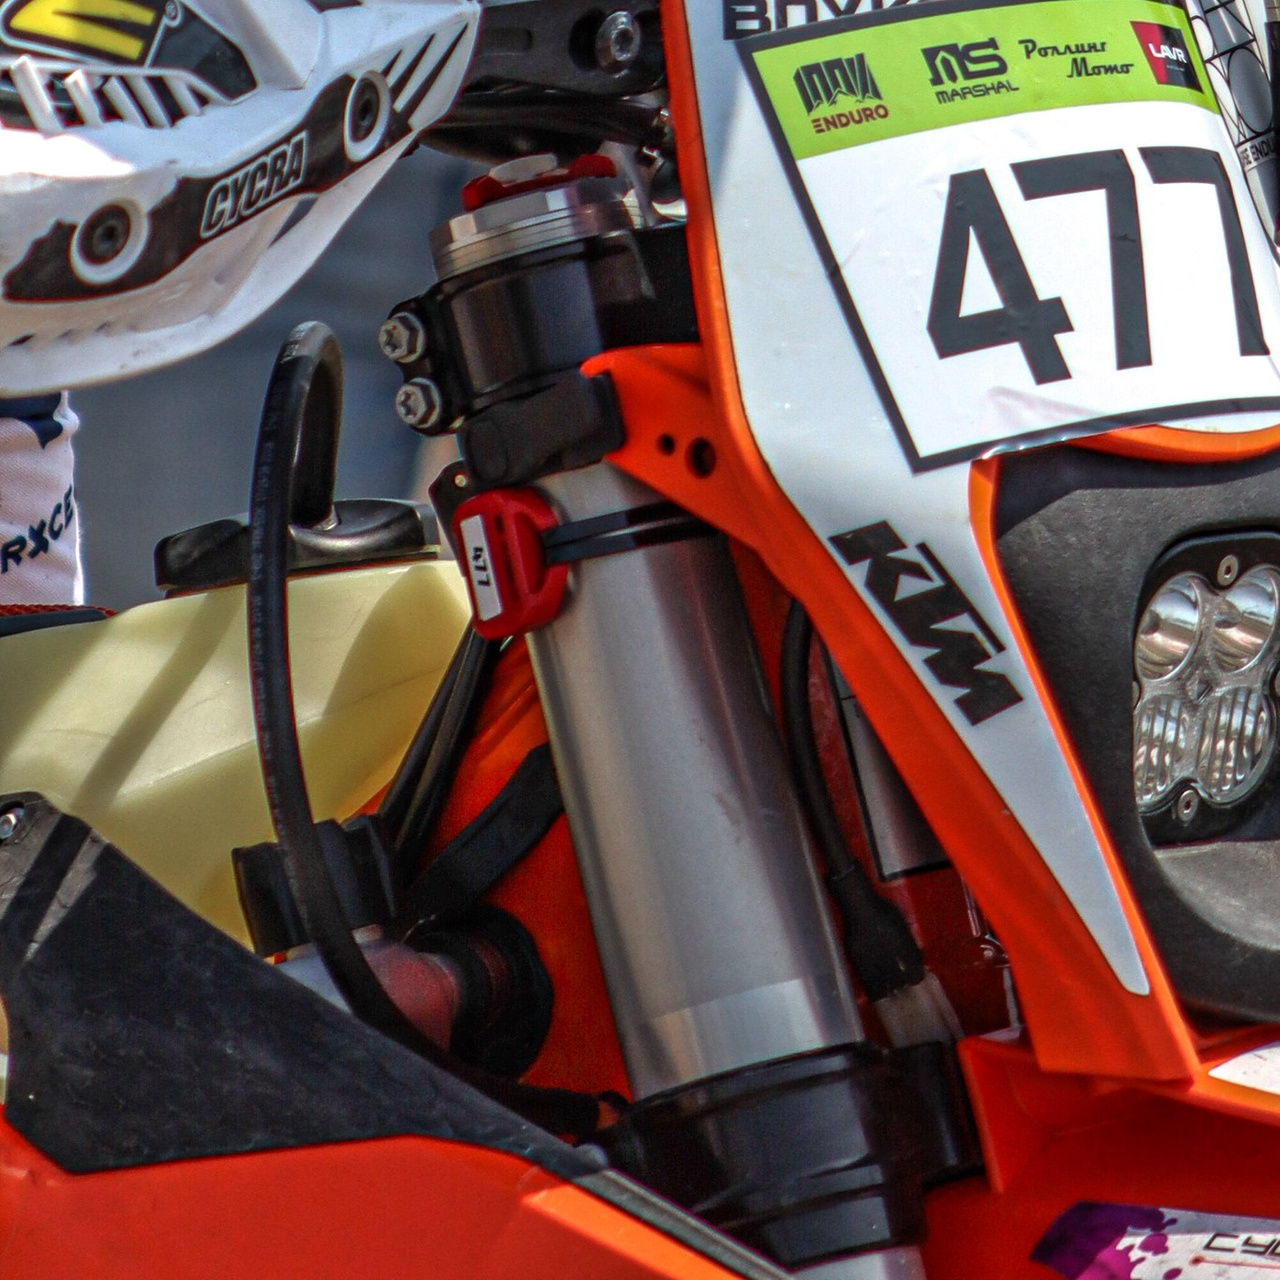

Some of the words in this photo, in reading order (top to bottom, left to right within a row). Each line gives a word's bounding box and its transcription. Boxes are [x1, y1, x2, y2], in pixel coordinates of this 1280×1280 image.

[1149, 43, 1187, 64] LAVR
[935, 79, 1020, 105] MARSHAL
[811, 104, 889, 134] ENDURO
[1250, 138, 1277, 162] ENDU
[201, 131, 308, 238] CYCRA
[926, 146, 1270, 385] 477
[827, 520, 1024, 726] KTM
